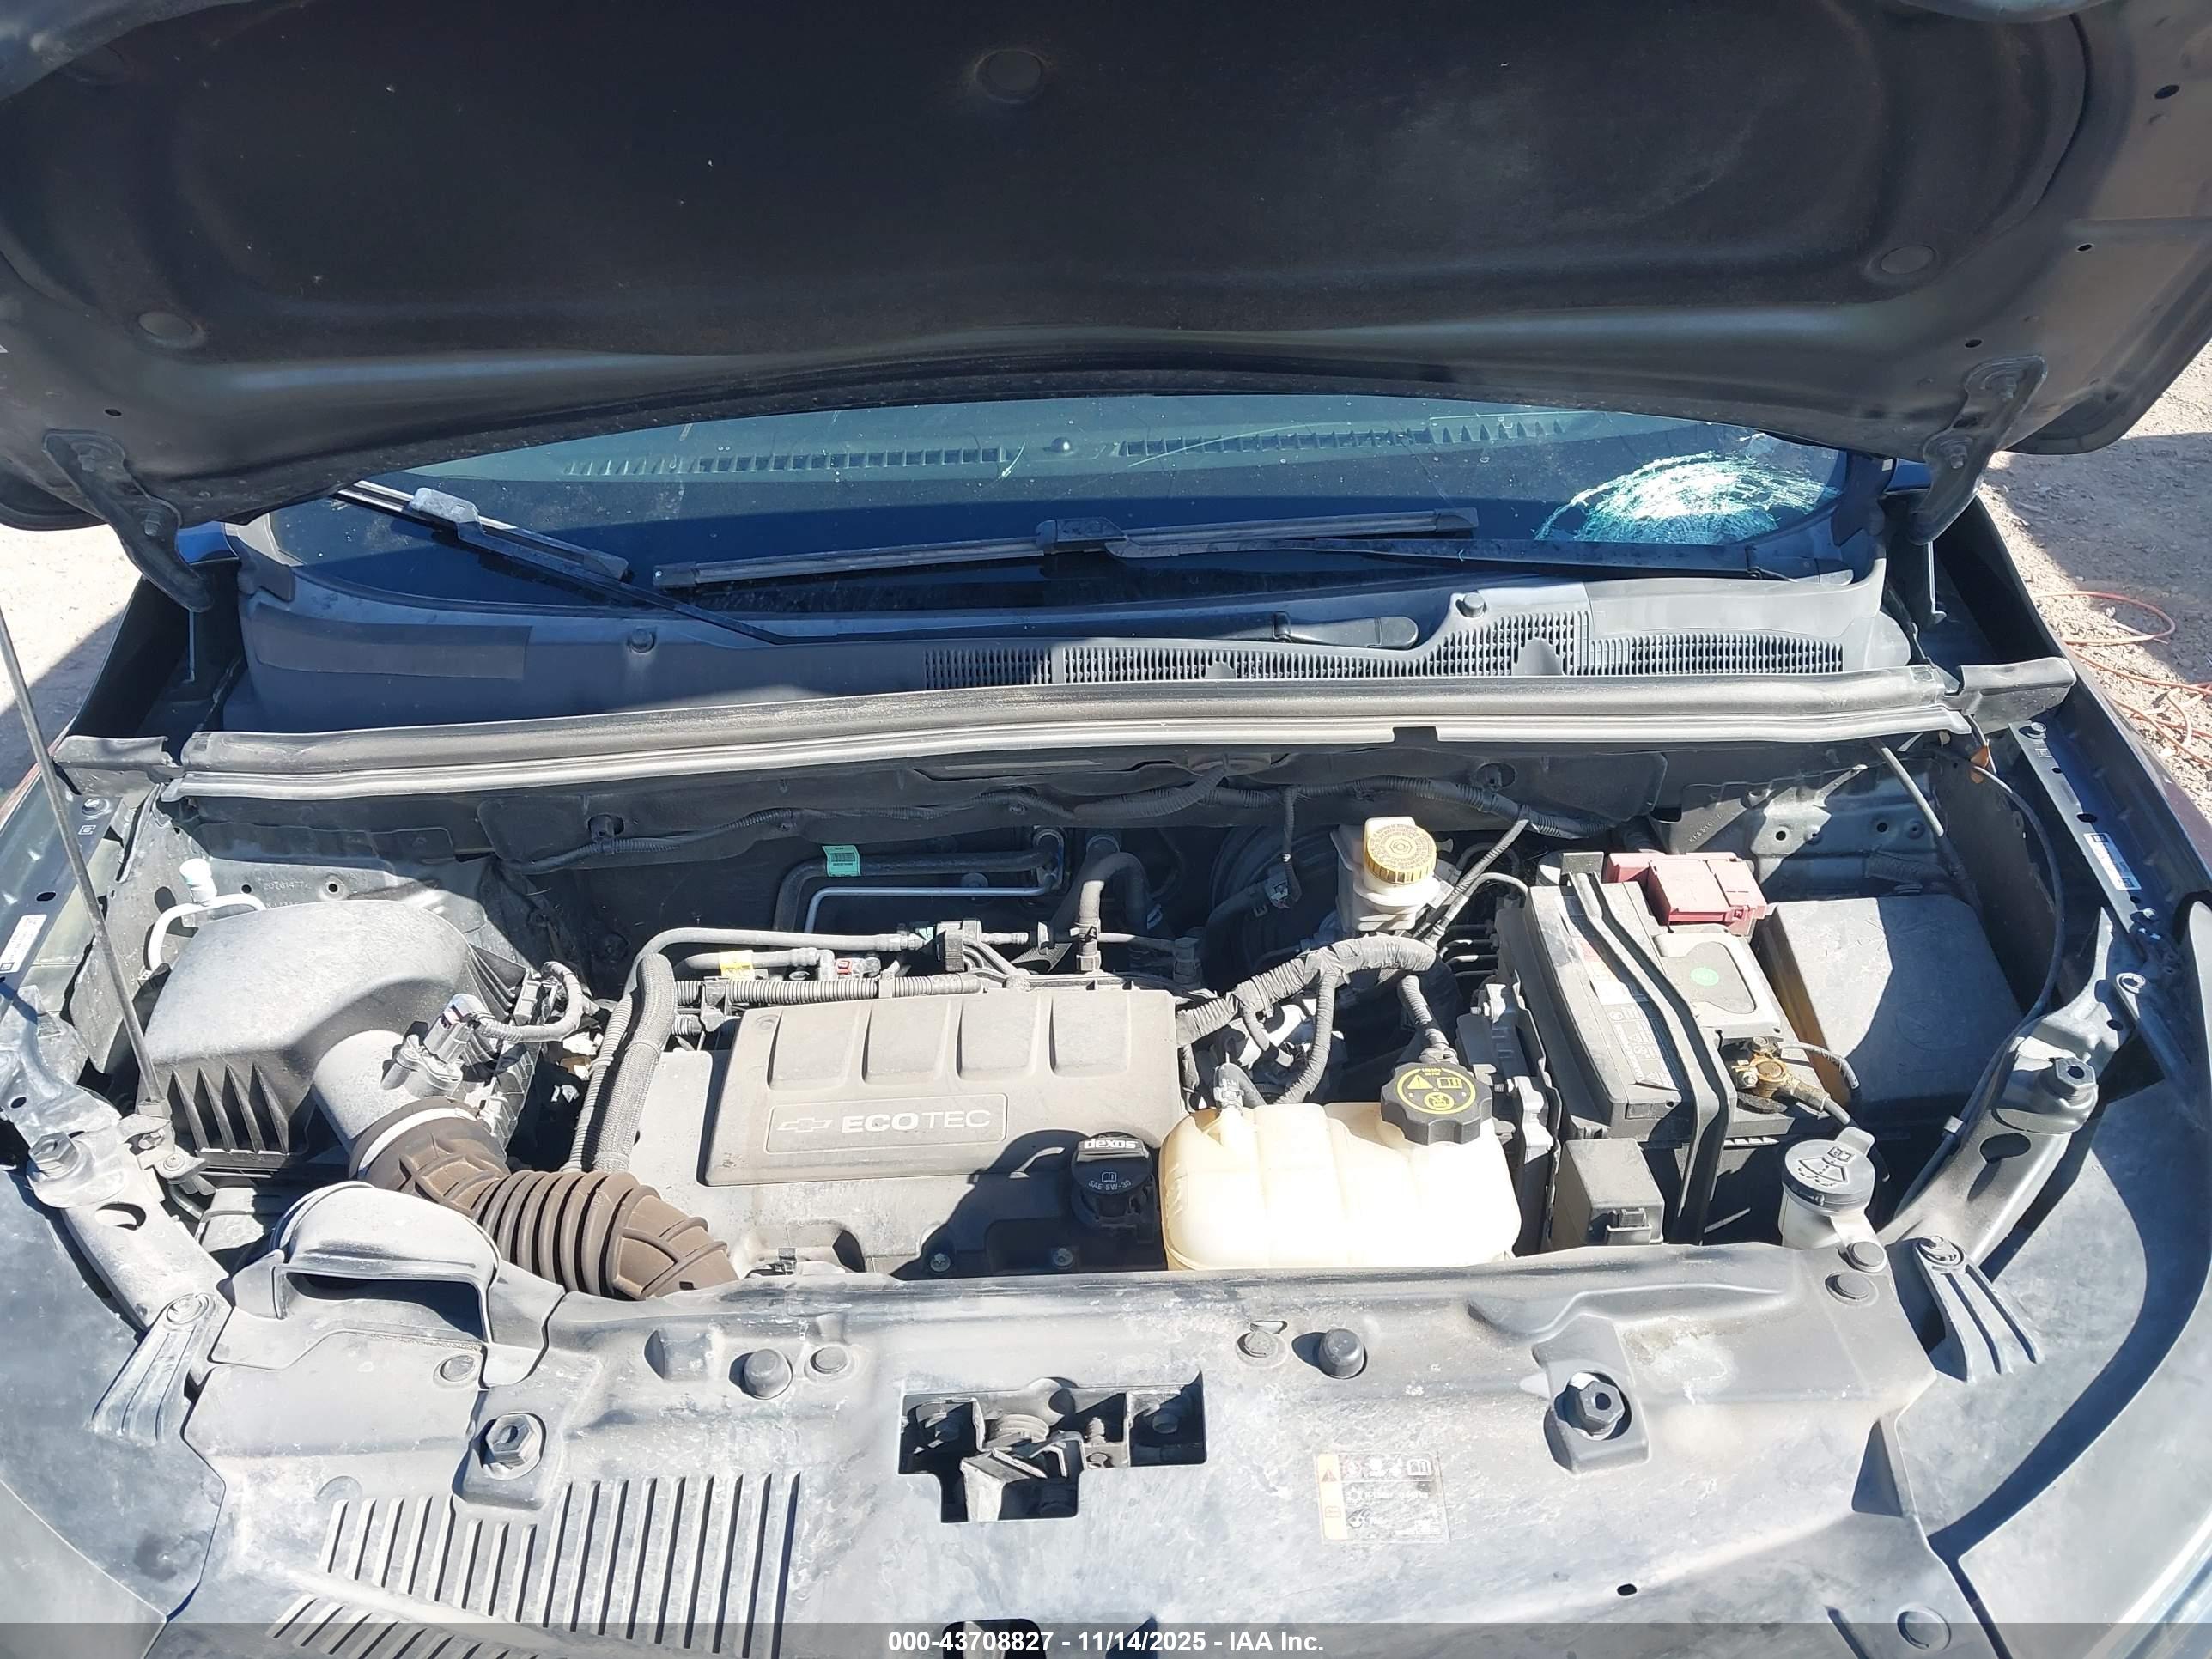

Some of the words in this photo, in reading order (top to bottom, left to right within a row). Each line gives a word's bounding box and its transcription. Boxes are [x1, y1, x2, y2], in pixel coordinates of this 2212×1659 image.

[841, 1110, 992, 1133] ECOTEC
[1084, 1138, 1139, 1149] dexos
[1088, 1180, 1103, 1190] SAE
[1105, 1180, 1132, 1191] 5W-30
